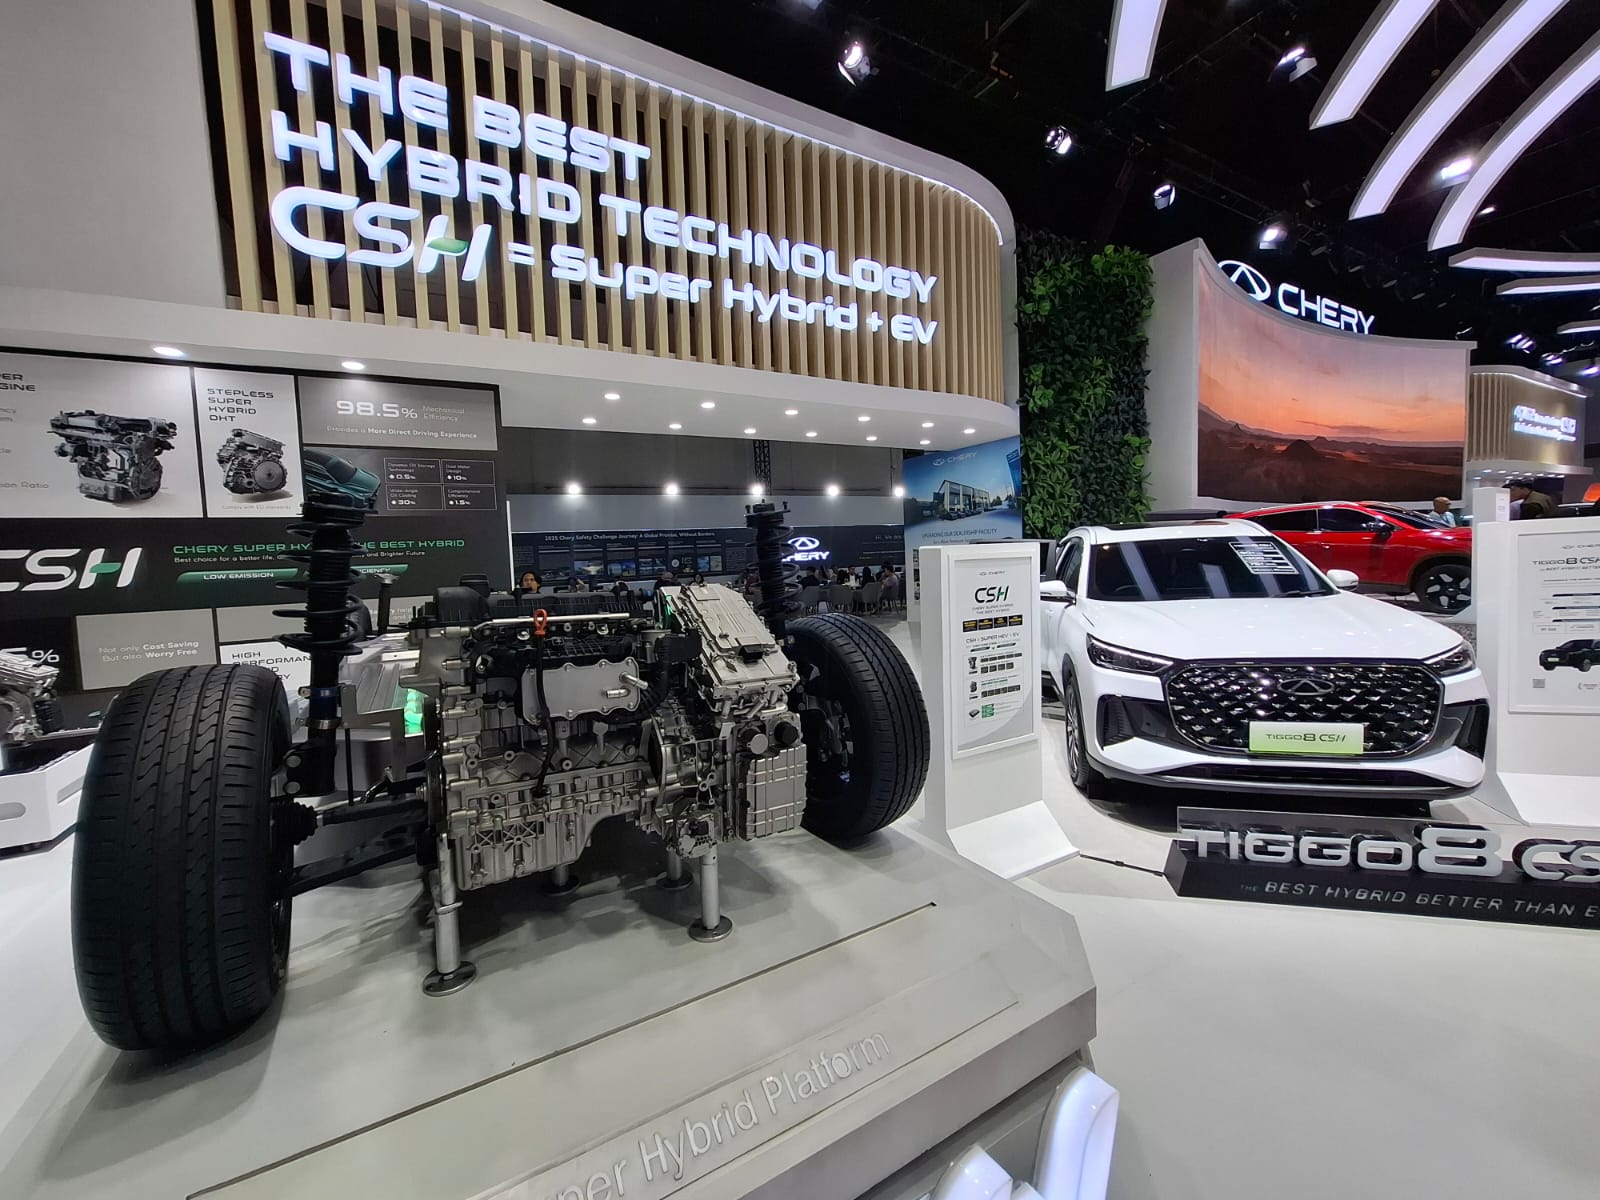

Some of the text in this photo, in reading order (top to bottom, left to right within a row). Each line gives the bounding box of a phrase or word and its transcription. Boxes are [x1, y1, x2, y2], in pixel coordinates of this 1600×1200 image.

[264, 31, 651, 181] THE BEST
[271, 110, 938, 303] HYBRID TECHNOLOGY
[271, 186, 938, 345] CSH = Super Hybrid + EV
[1278, 282, 1375, 335] CHERY
[0, 373, 23, 381] ER
[207, 388, 274, 399] STEPLESS
[208, 397, 252, 406] SUPER
[208, 405, 257, 415] HYBRID
[336, 400, 418, 419] 98.5%
[209, 414, 236, 422] DHT
[367, 427, 387, 435] More
[388, 428, 411, 436] Direct
[412, 429, 439, 438] Driving
[440, 431, 478, 439] Experience
[21, 481, 49, 489] Ratio
[173, 545, 229, 554] CHERY
[233, 543, 286, 553] SUPER
[380, 541, 415, 549] BEST
[418, 539, 465, 548] HYBRID
[380, 550, 405, 558] Brighter
[974, 585, 1010, 603] CSH
[120, 644, 140, 652] only
[167, 641, 199, 649] Saving
[232, 651, 261, 659] HIGH
[1265, 733, 1347, 742] TIGGO8 CSH
[1181, 826, 1503, 877] TIGGO8
[1265, 880, 1319, 898] BEST
[1326, 885, 1406, 903] HYBRID
[1416, 893, 1503, 910] BETTER
[1514, 900, 1577, 918] THAN
[637, 1089, 760, 1181] Hybrid
[760, 1031, 891, 1115] Platform
